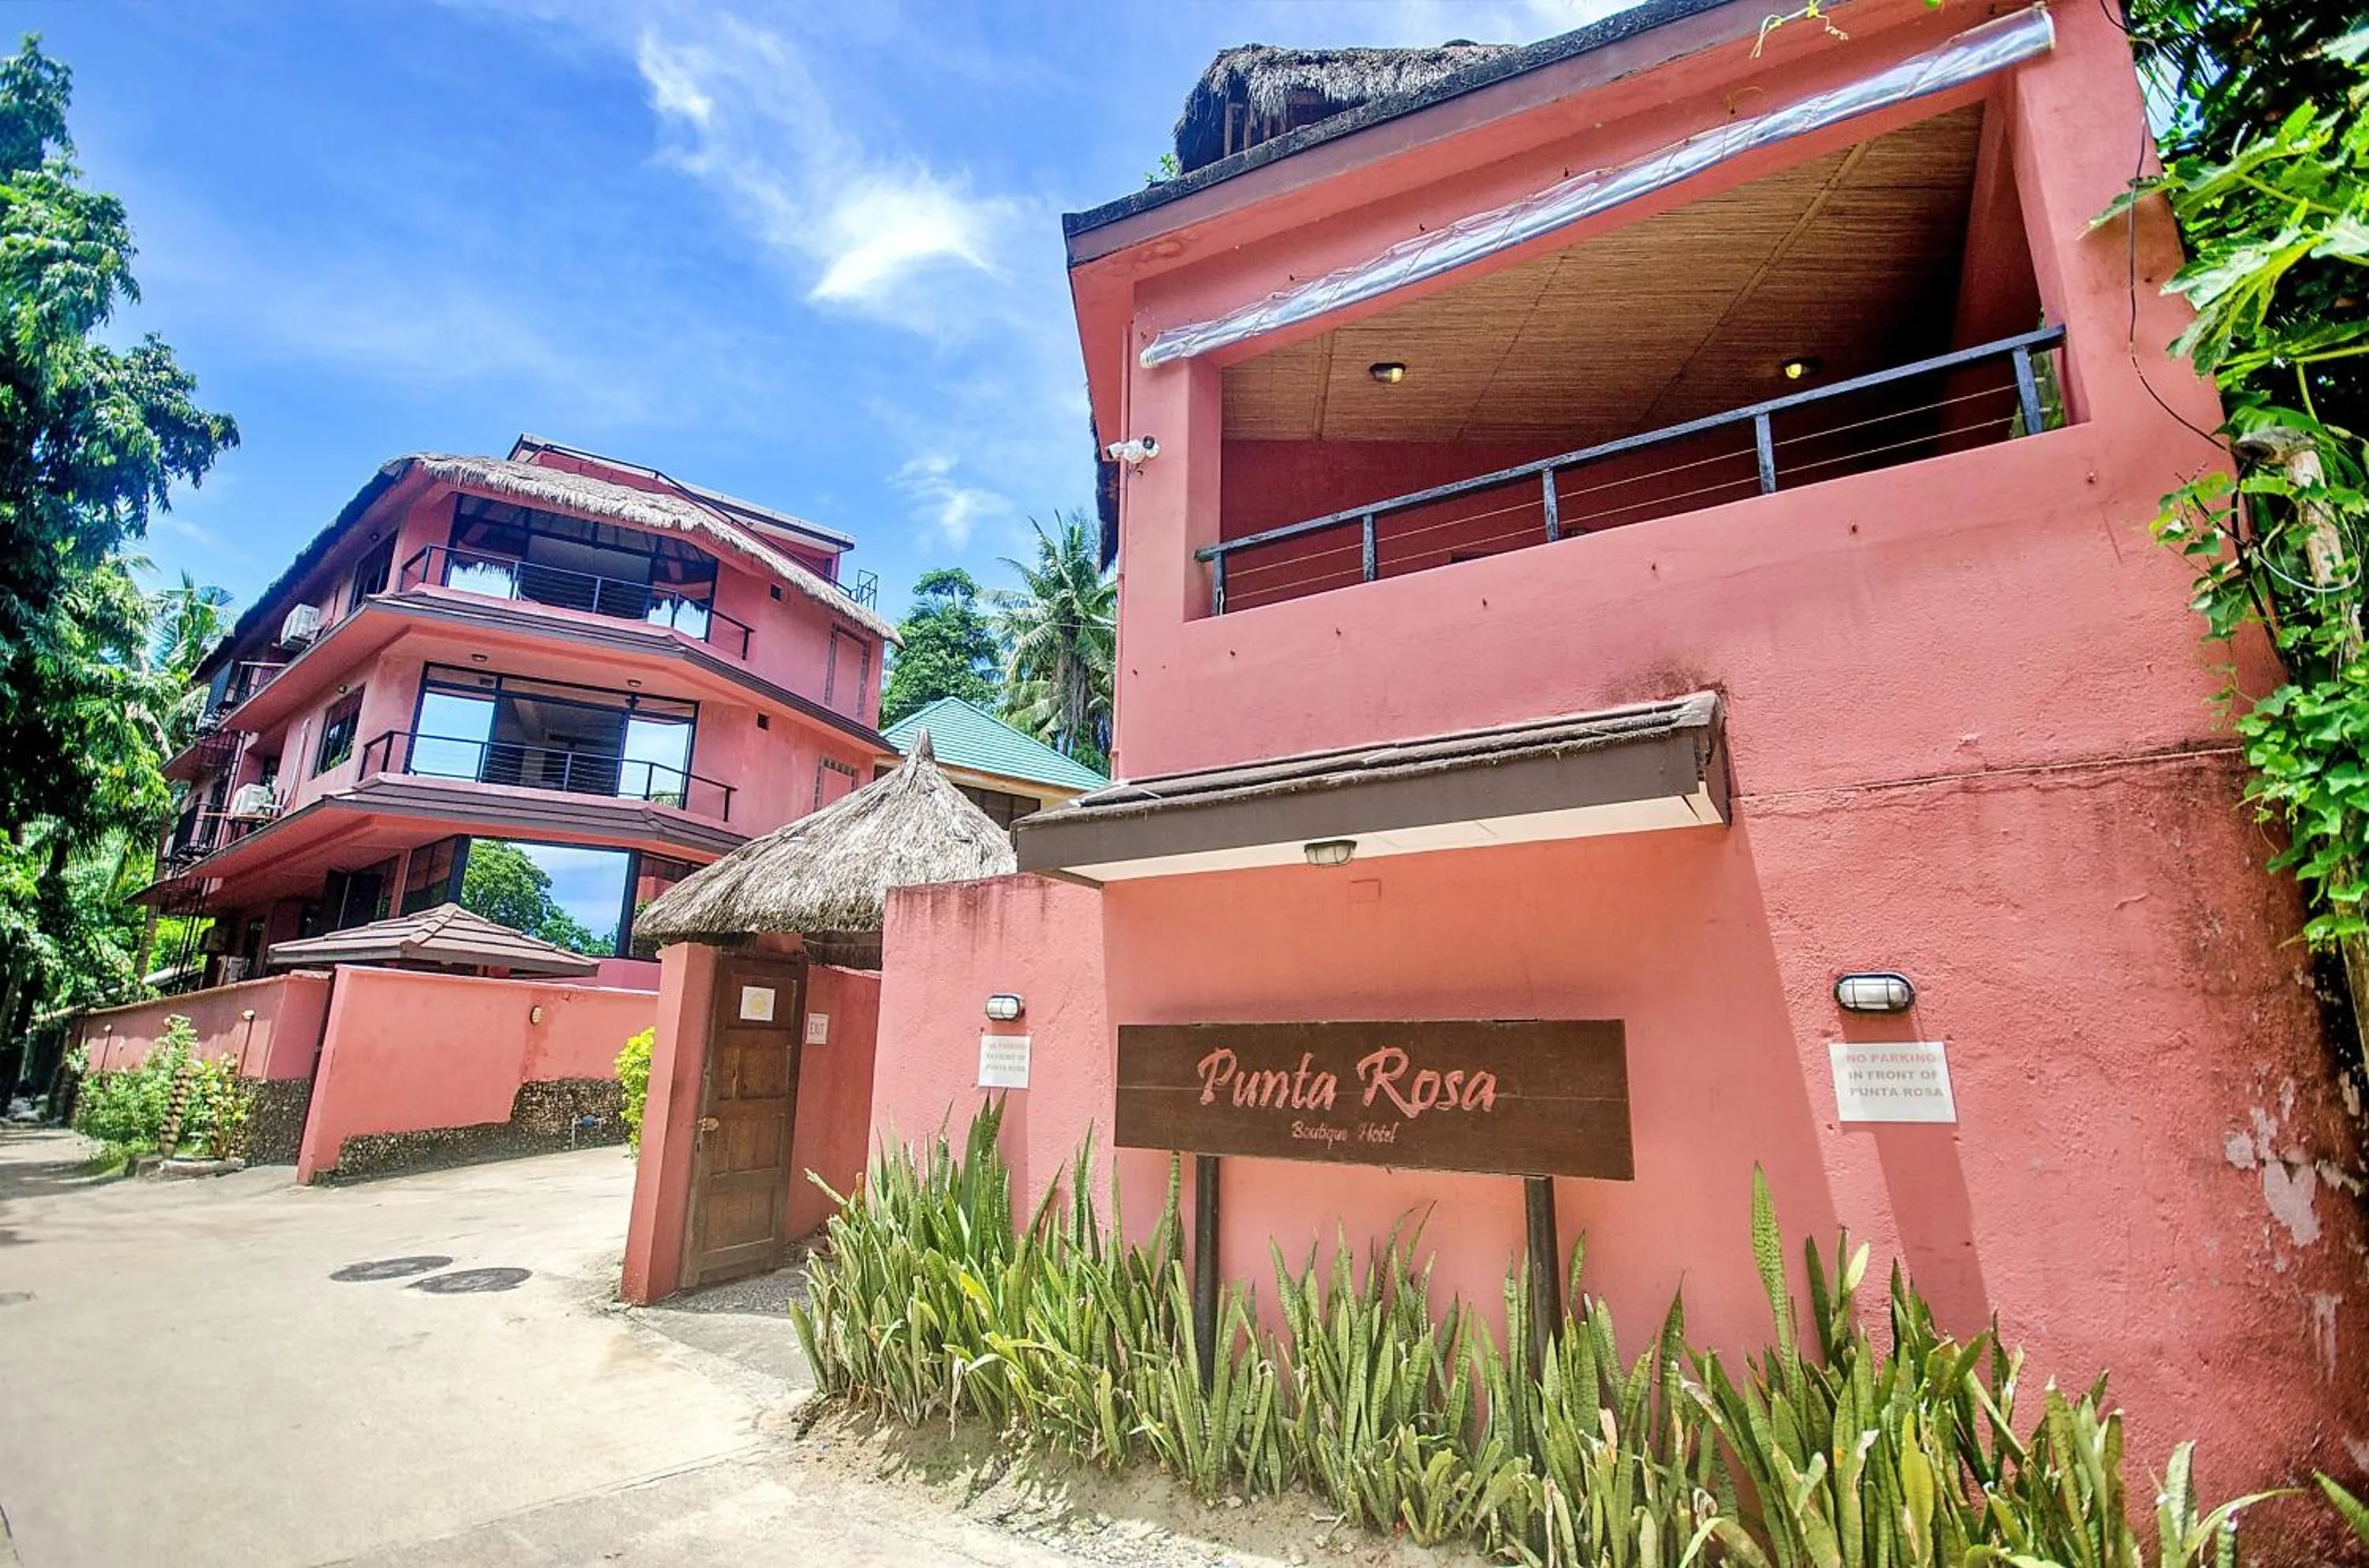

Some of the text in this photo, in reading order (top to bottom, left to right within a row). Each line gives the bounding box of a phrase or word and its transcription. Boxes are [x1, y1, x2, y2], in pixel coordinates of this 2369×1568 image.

[809, 1022, 825, 1035] EXIT
[1846, 1052, 1936, 1063] NO PARKING
[1849, 1070, 1938, 1080] IN FRONT OF
[1197, 1045, 1497, 1119] Punta Rosa
[1850, 1087, 1943, 1097] PUNTA ROSA
[1291, 1120, 1399, 1150] Boutique Hotel
